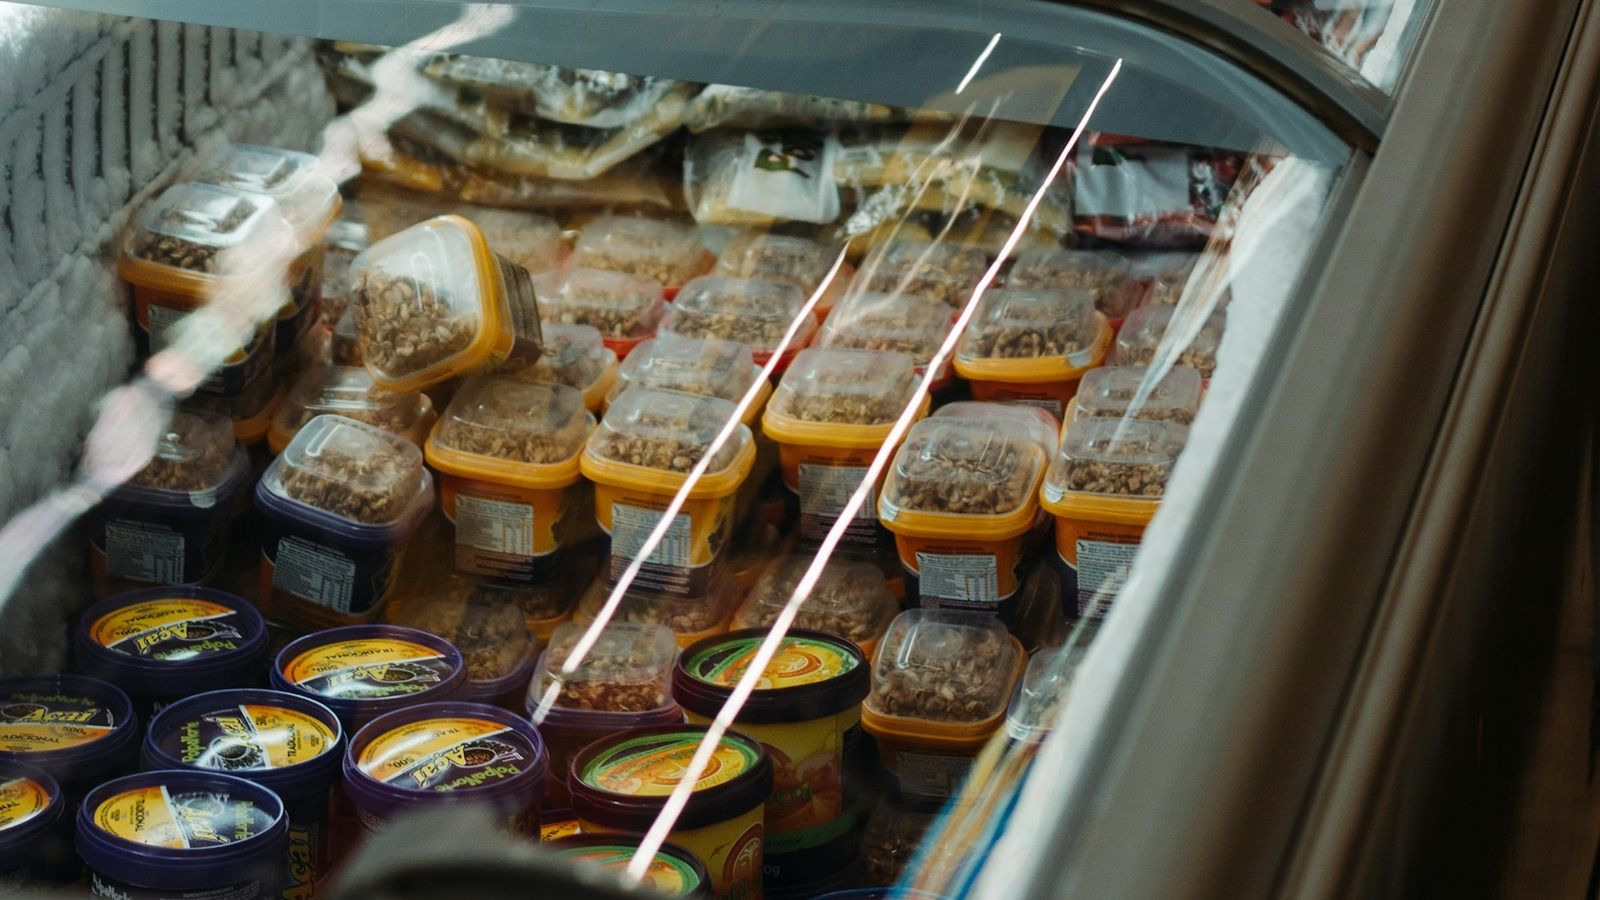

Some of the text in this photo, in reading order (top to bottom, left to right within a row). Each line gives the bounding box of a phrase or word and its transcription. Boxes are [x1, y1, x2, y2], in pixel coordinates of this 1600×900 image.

[133, 622, 189, 657] Açaí
[409, 744, 467, 790] Açaí
[433, 763, 521, 792] PolpaNorte
